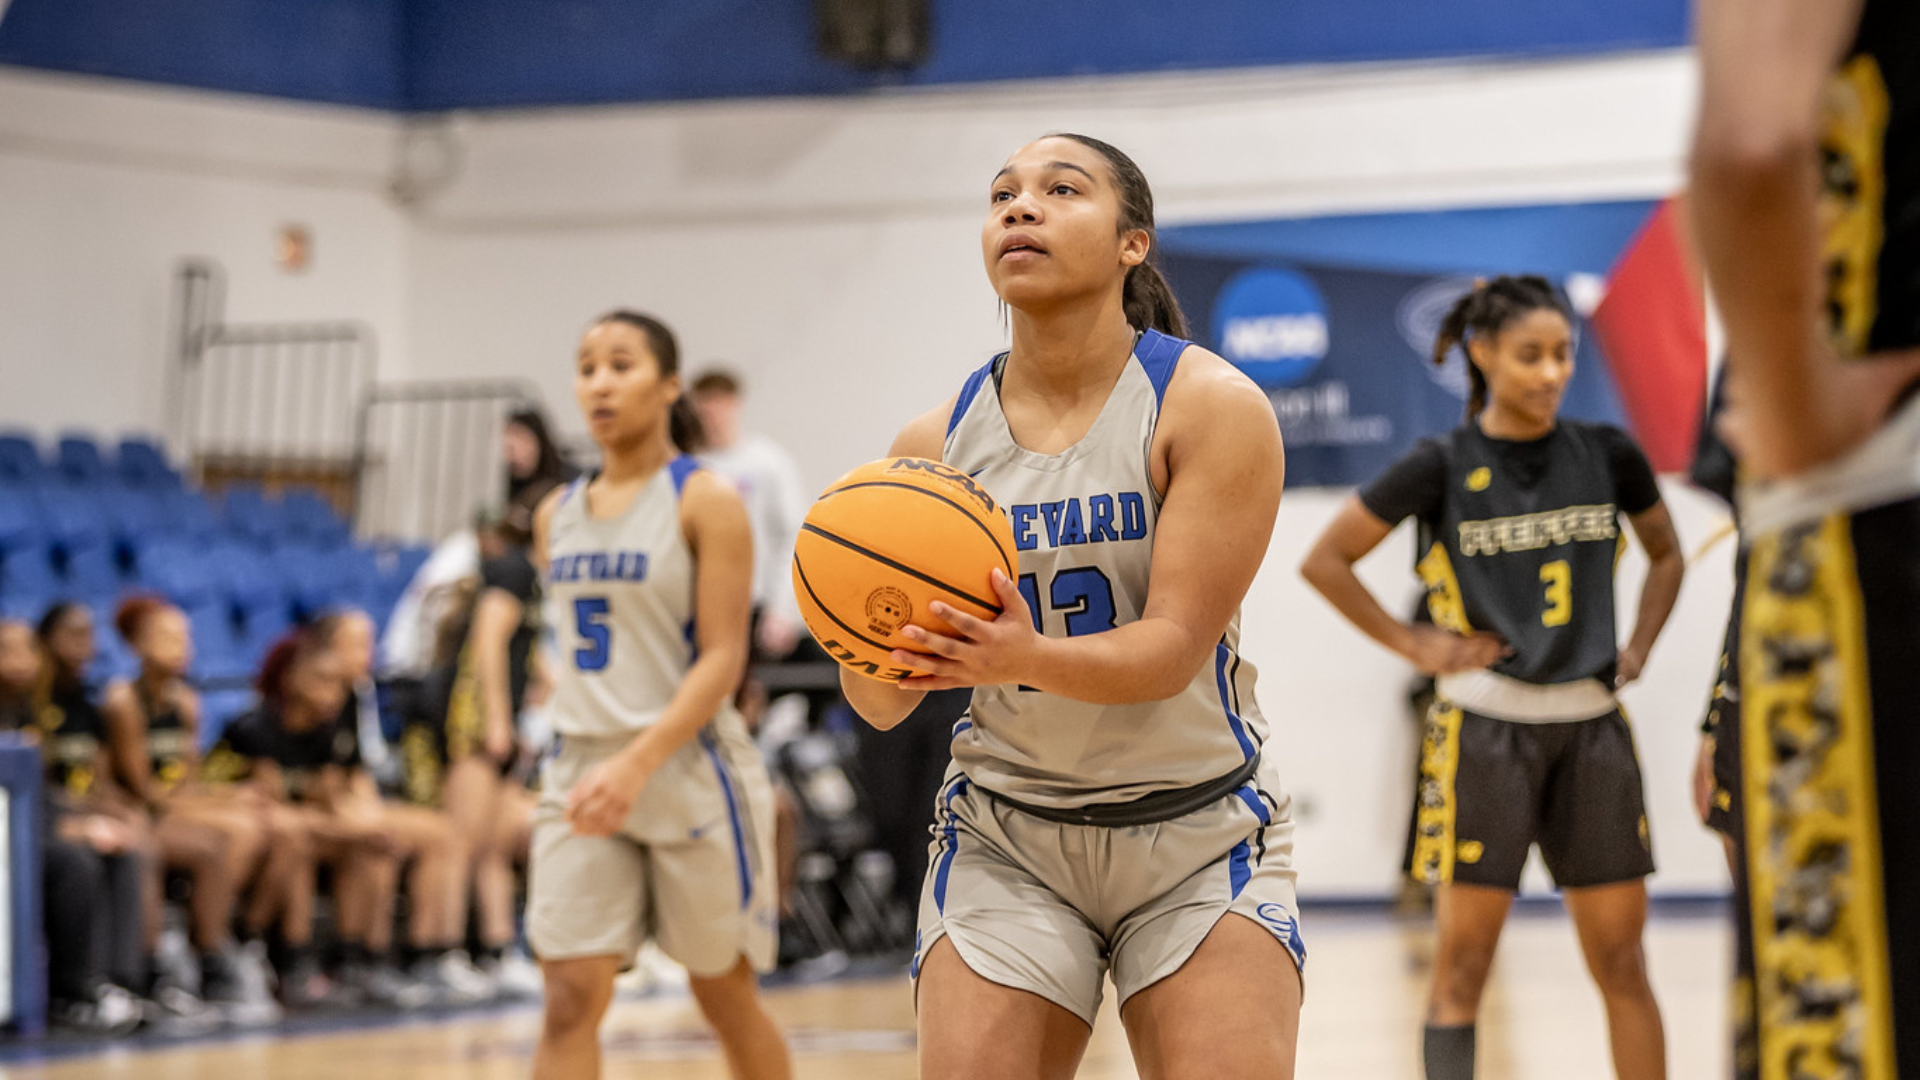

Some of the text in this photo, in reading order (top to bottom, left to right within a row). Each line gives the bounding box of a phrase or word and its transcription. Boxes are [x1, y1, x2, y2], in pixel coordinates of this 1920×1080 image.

[889, 458, 995, 514] NCAA
[1003, 491, 1148, 551] EVARD
[1539, 559, 1572, 628] 3
[574, 597, 610, 671] 5
